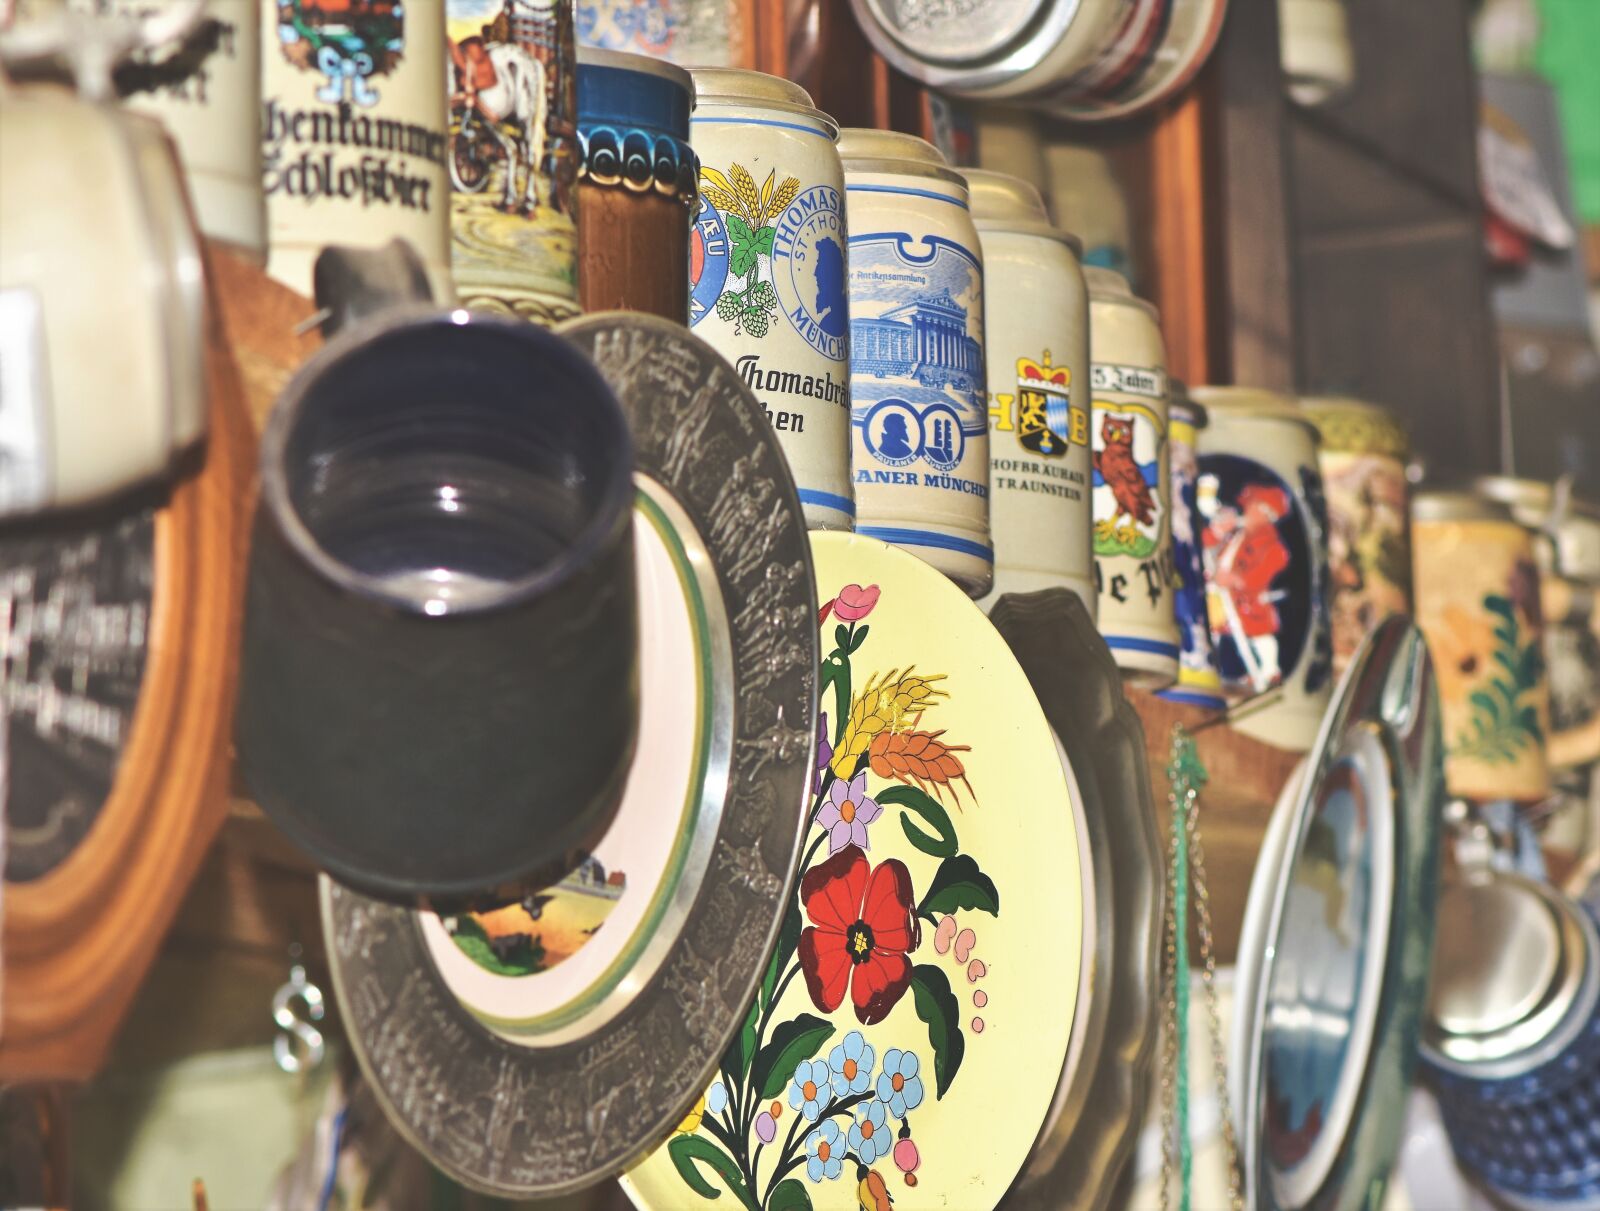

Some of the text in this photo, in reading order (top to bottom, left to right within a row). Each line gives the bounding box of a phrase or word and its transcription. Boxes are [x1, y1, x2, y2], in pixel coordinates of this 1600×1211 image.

[1069, 406, 1089, 446] B
[872, 451, 918, 468] PAULANER
[996, 477, 1081, 502] TRAUNSTEIN
